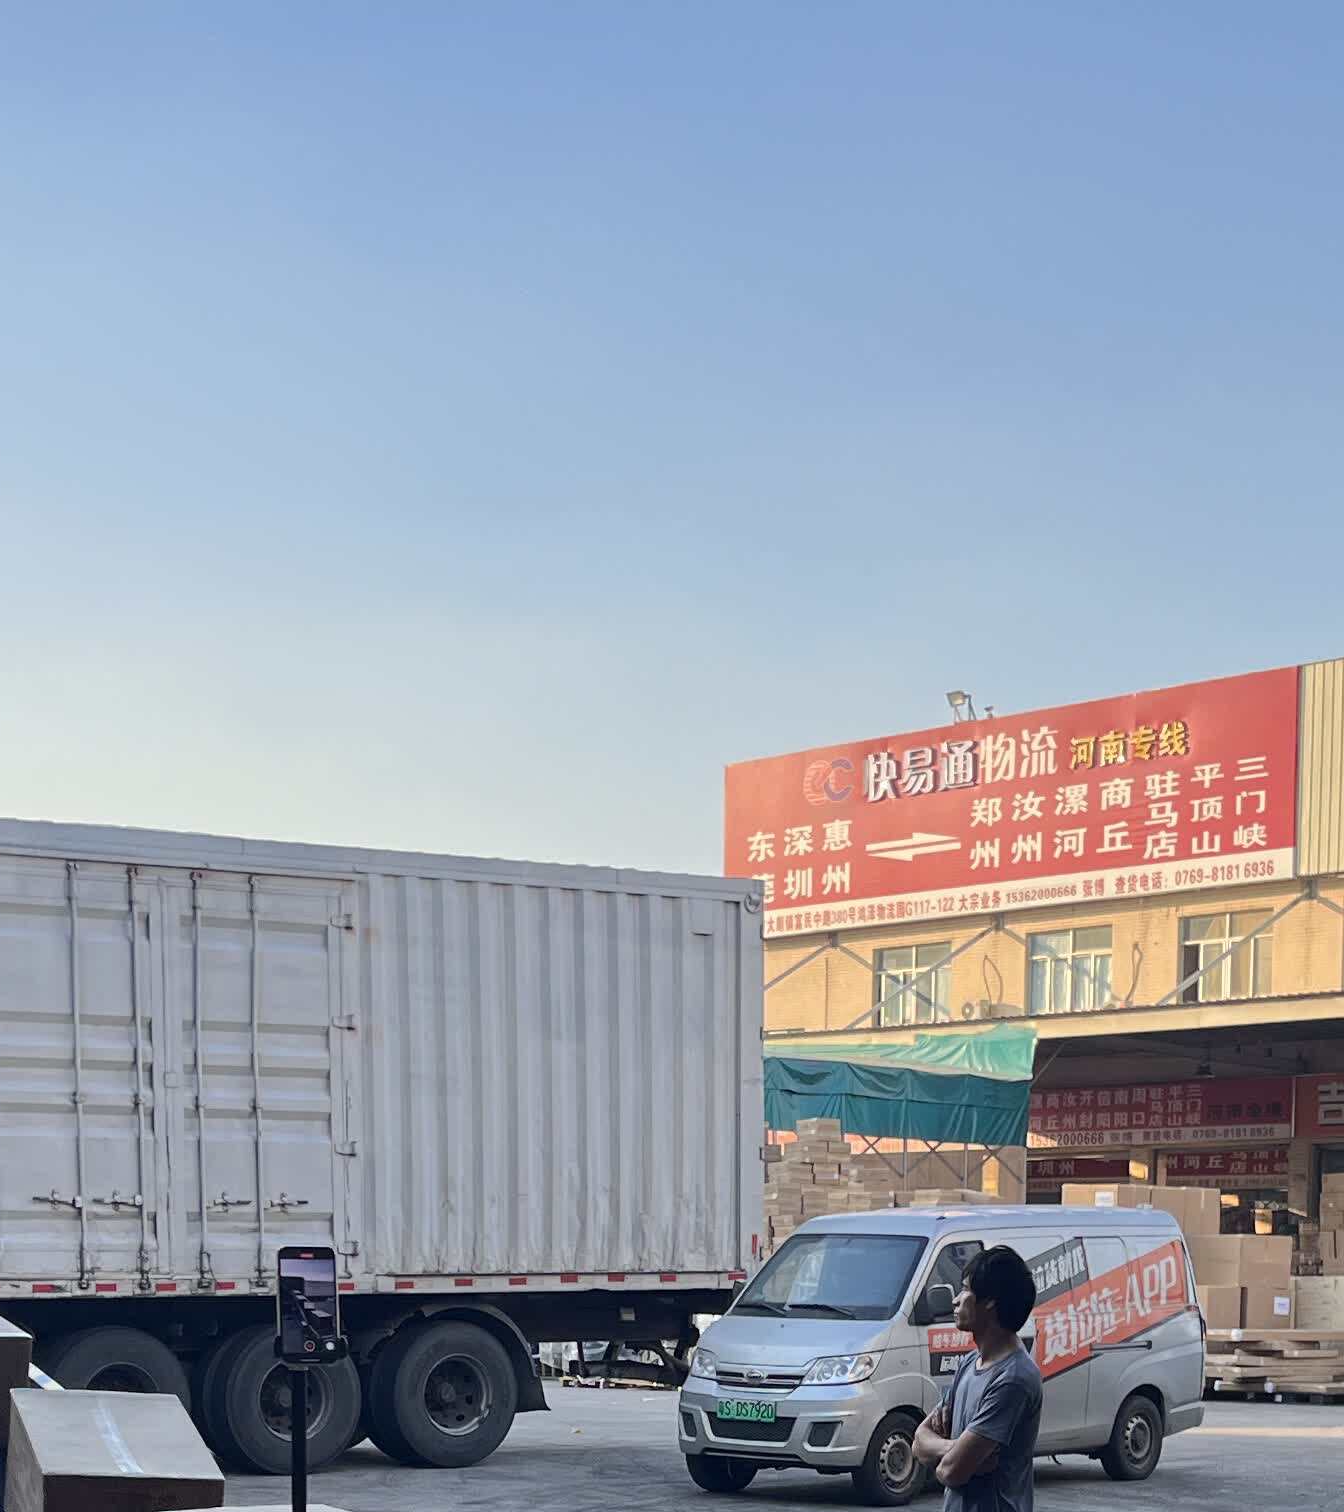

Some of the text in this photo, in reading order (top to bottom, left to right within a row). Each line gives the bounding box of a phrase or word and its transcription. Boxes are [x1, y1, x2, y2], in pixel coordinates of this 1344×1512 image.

[863, 720, 1190, 803] 快易通物流 河南专线
[969, 796, 1003, 871] 郑州
[1011, 789, 1046, 865] 汝州
[1053, 783, 1089, 860] 漯河
[1096, 777, 1134, 854] 商丘
[1143, 770, 1182, 860] 驻马店
[1190, 763, 1225, 855] 平顶山
[1233, 756, 1269, 850] 三门峡
[783, 825, 814, 900] 深圳
[821, 819, 853, 896] 惠州
